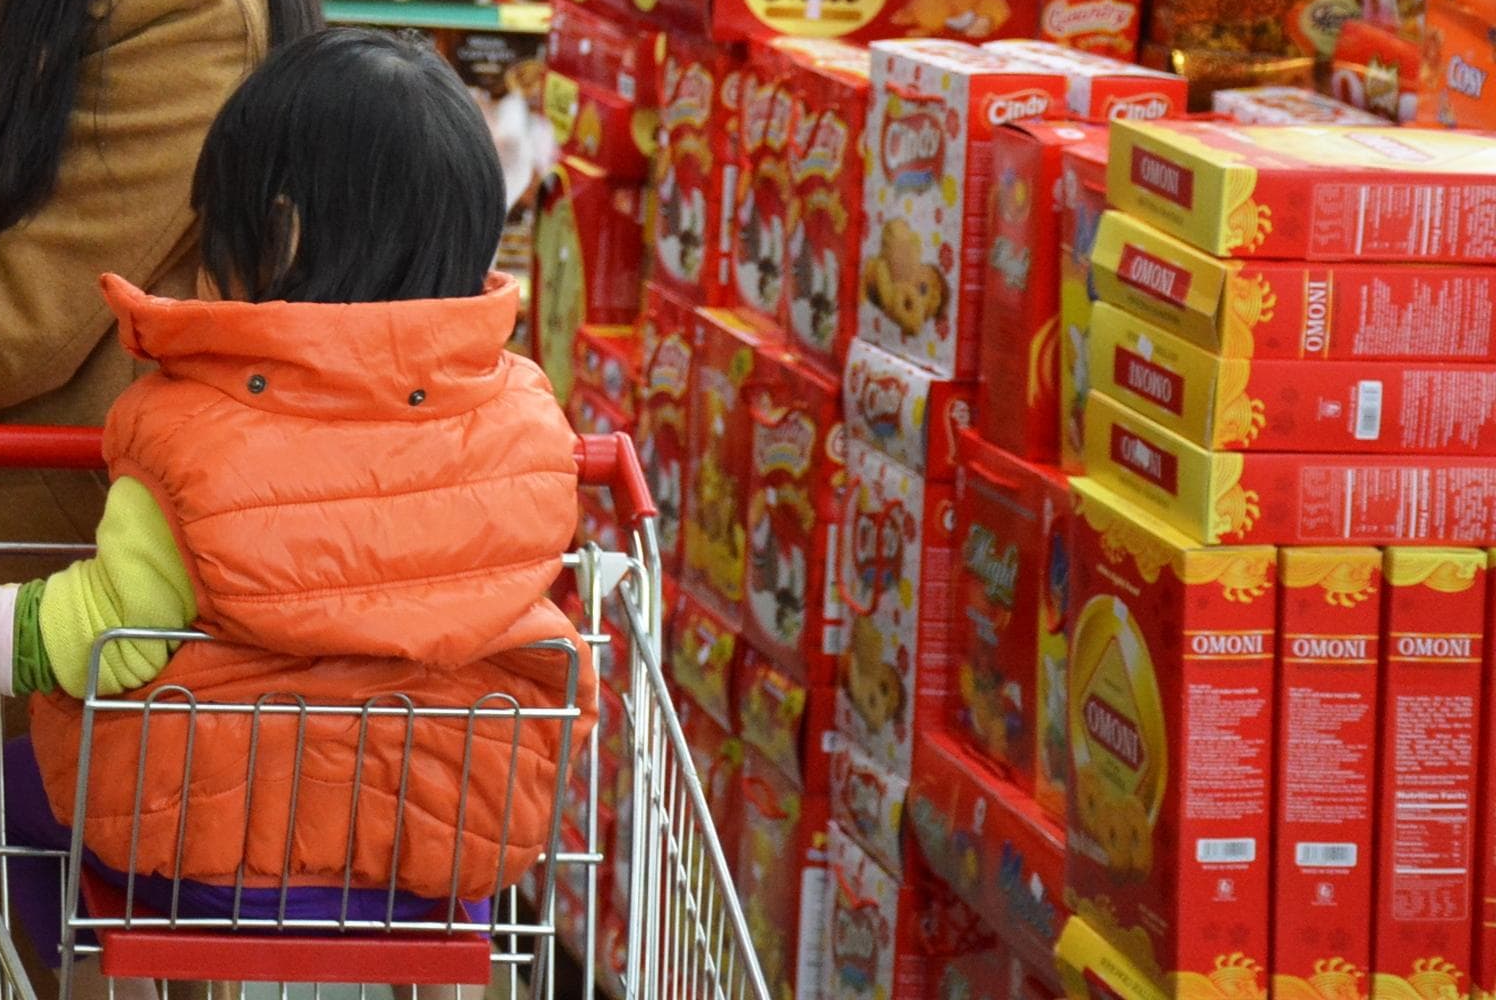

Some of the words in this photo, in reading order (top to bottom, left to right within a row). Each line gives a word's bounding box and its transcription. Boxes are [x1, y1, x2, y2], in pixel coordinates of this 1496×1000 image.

[988, 95, 1048, 126] Cindy
[1107, 99, 1168, 122] Cindy
[1140, 155, 1181, 197] OMONI
[1129, 253, 1177, 297] OMONI
[1305, 280, 1328, 352] OMONI
[1191, 634, 1264, 654] OMONI
[1292, 638, 1367, 659] OMONI
[1398, 637, 1472, 657] OMONI
[1086, 700, 1141, 766] OMONI
